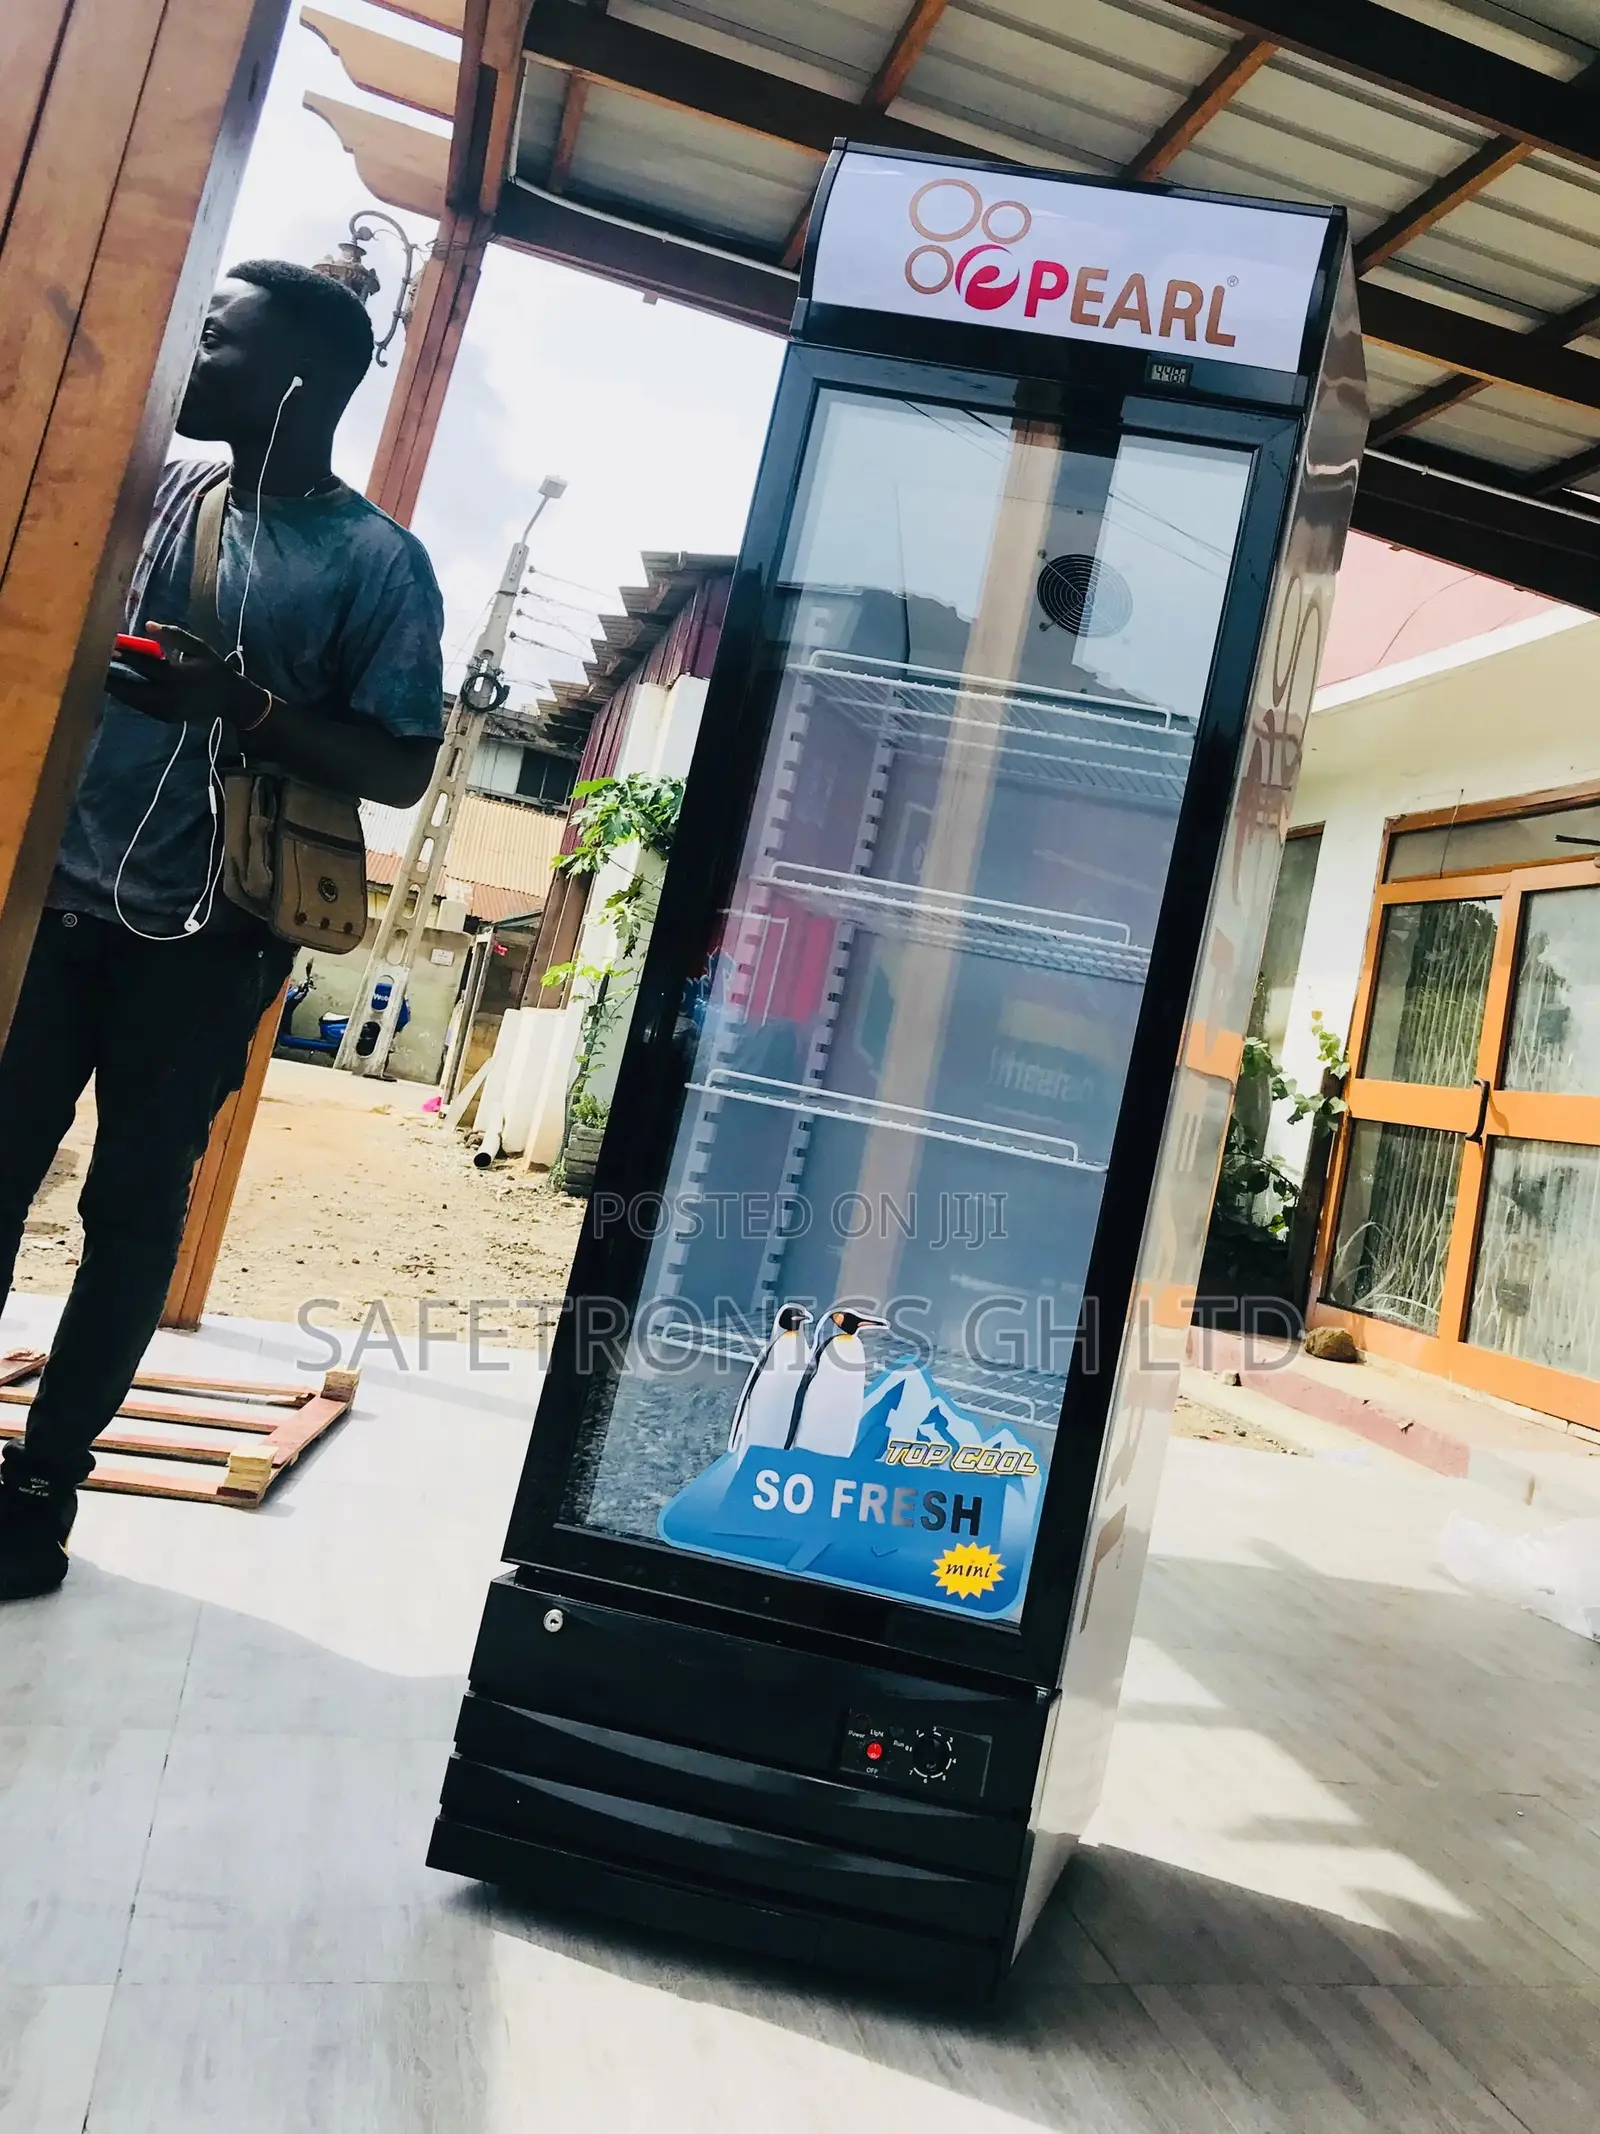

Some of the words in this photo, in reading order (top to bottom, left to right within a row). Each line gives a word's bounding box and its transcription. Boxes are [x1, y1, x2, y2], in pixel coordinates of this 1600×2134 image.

[1024, 260, 1236, 347] PEARL
[887, 1440, 951, 1466] TOP
[951, 1446, 1038, 1475] COOL
[752, 1469, 814, 1514] SO
[831, 1479, 982, 1536] FRESH
[945, 1558, 993, 1579] mini
